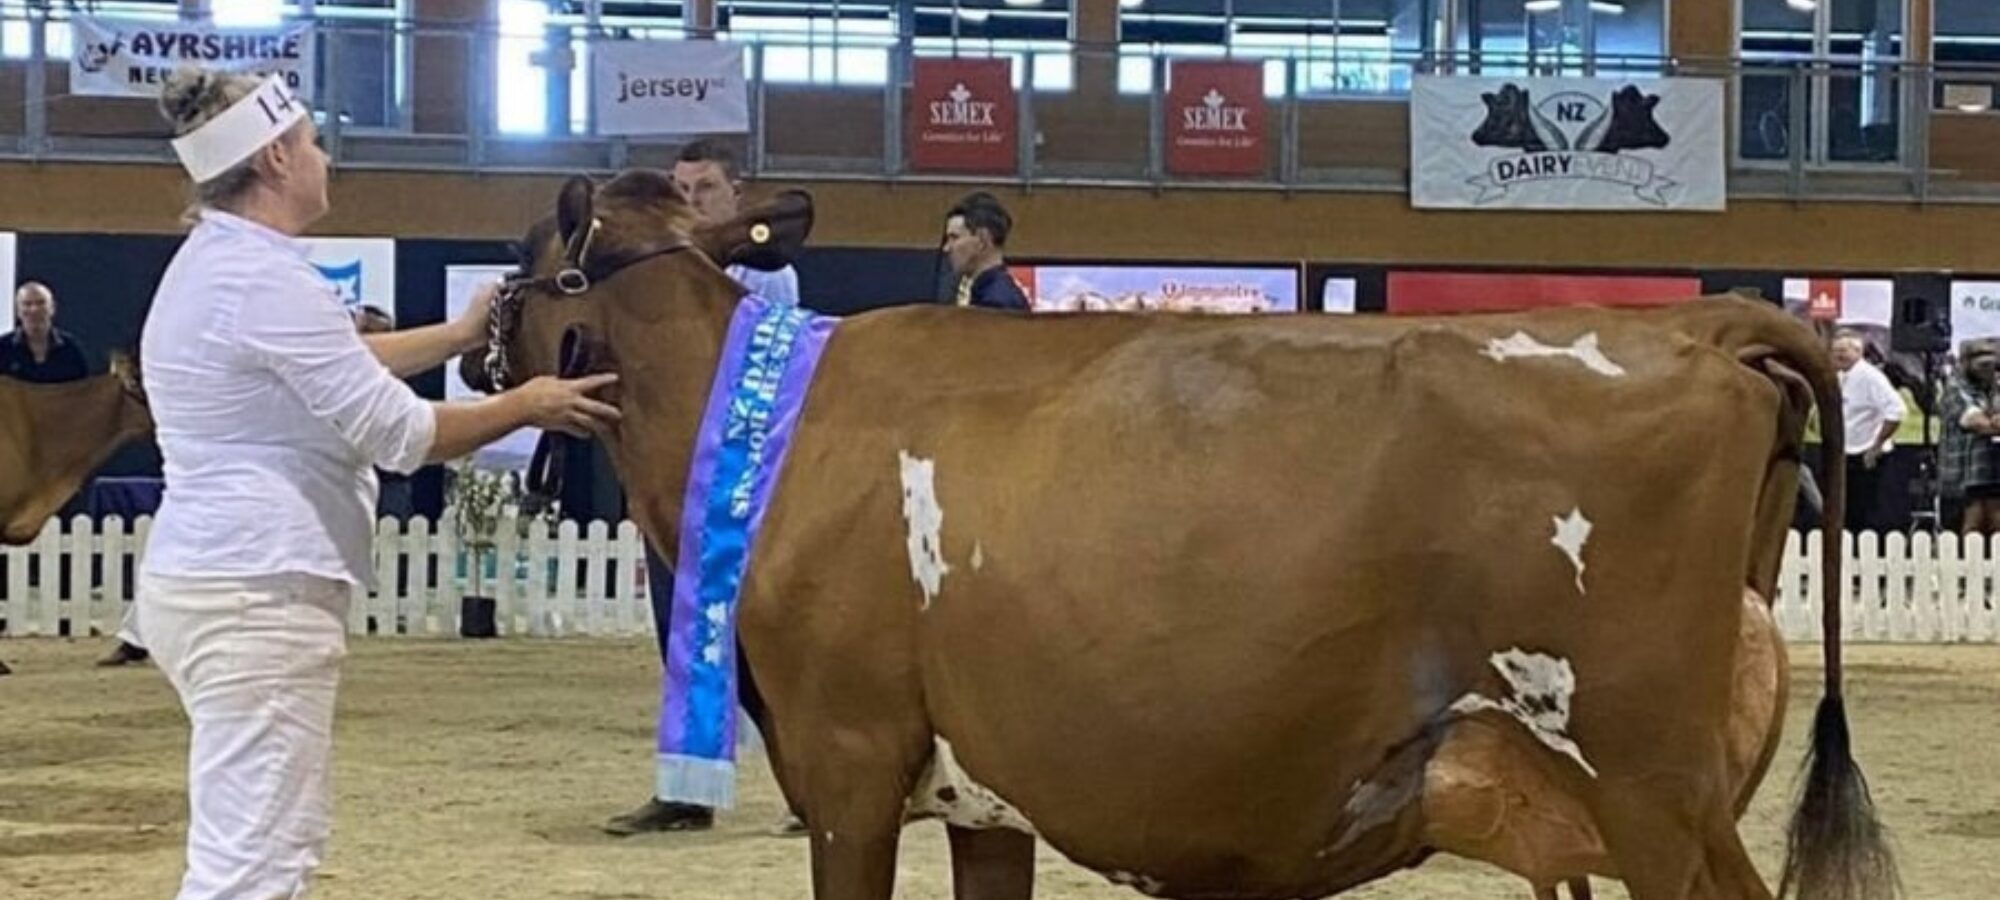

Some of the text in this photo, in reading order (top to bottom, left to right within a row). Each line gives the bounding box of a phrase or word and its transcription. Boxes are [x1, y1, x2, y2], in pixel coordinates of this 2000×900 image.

[131, 32, 299, 59] AYRSHIRE
[617, 71, 709, 102] jersey
[930, 101, 995, 126] SEMEX
[1183, 106, 1248, 130] SEMEX
[1557, 102, 1586, 122] NZ
[1498, 154, 1572, 180] DAIRY
